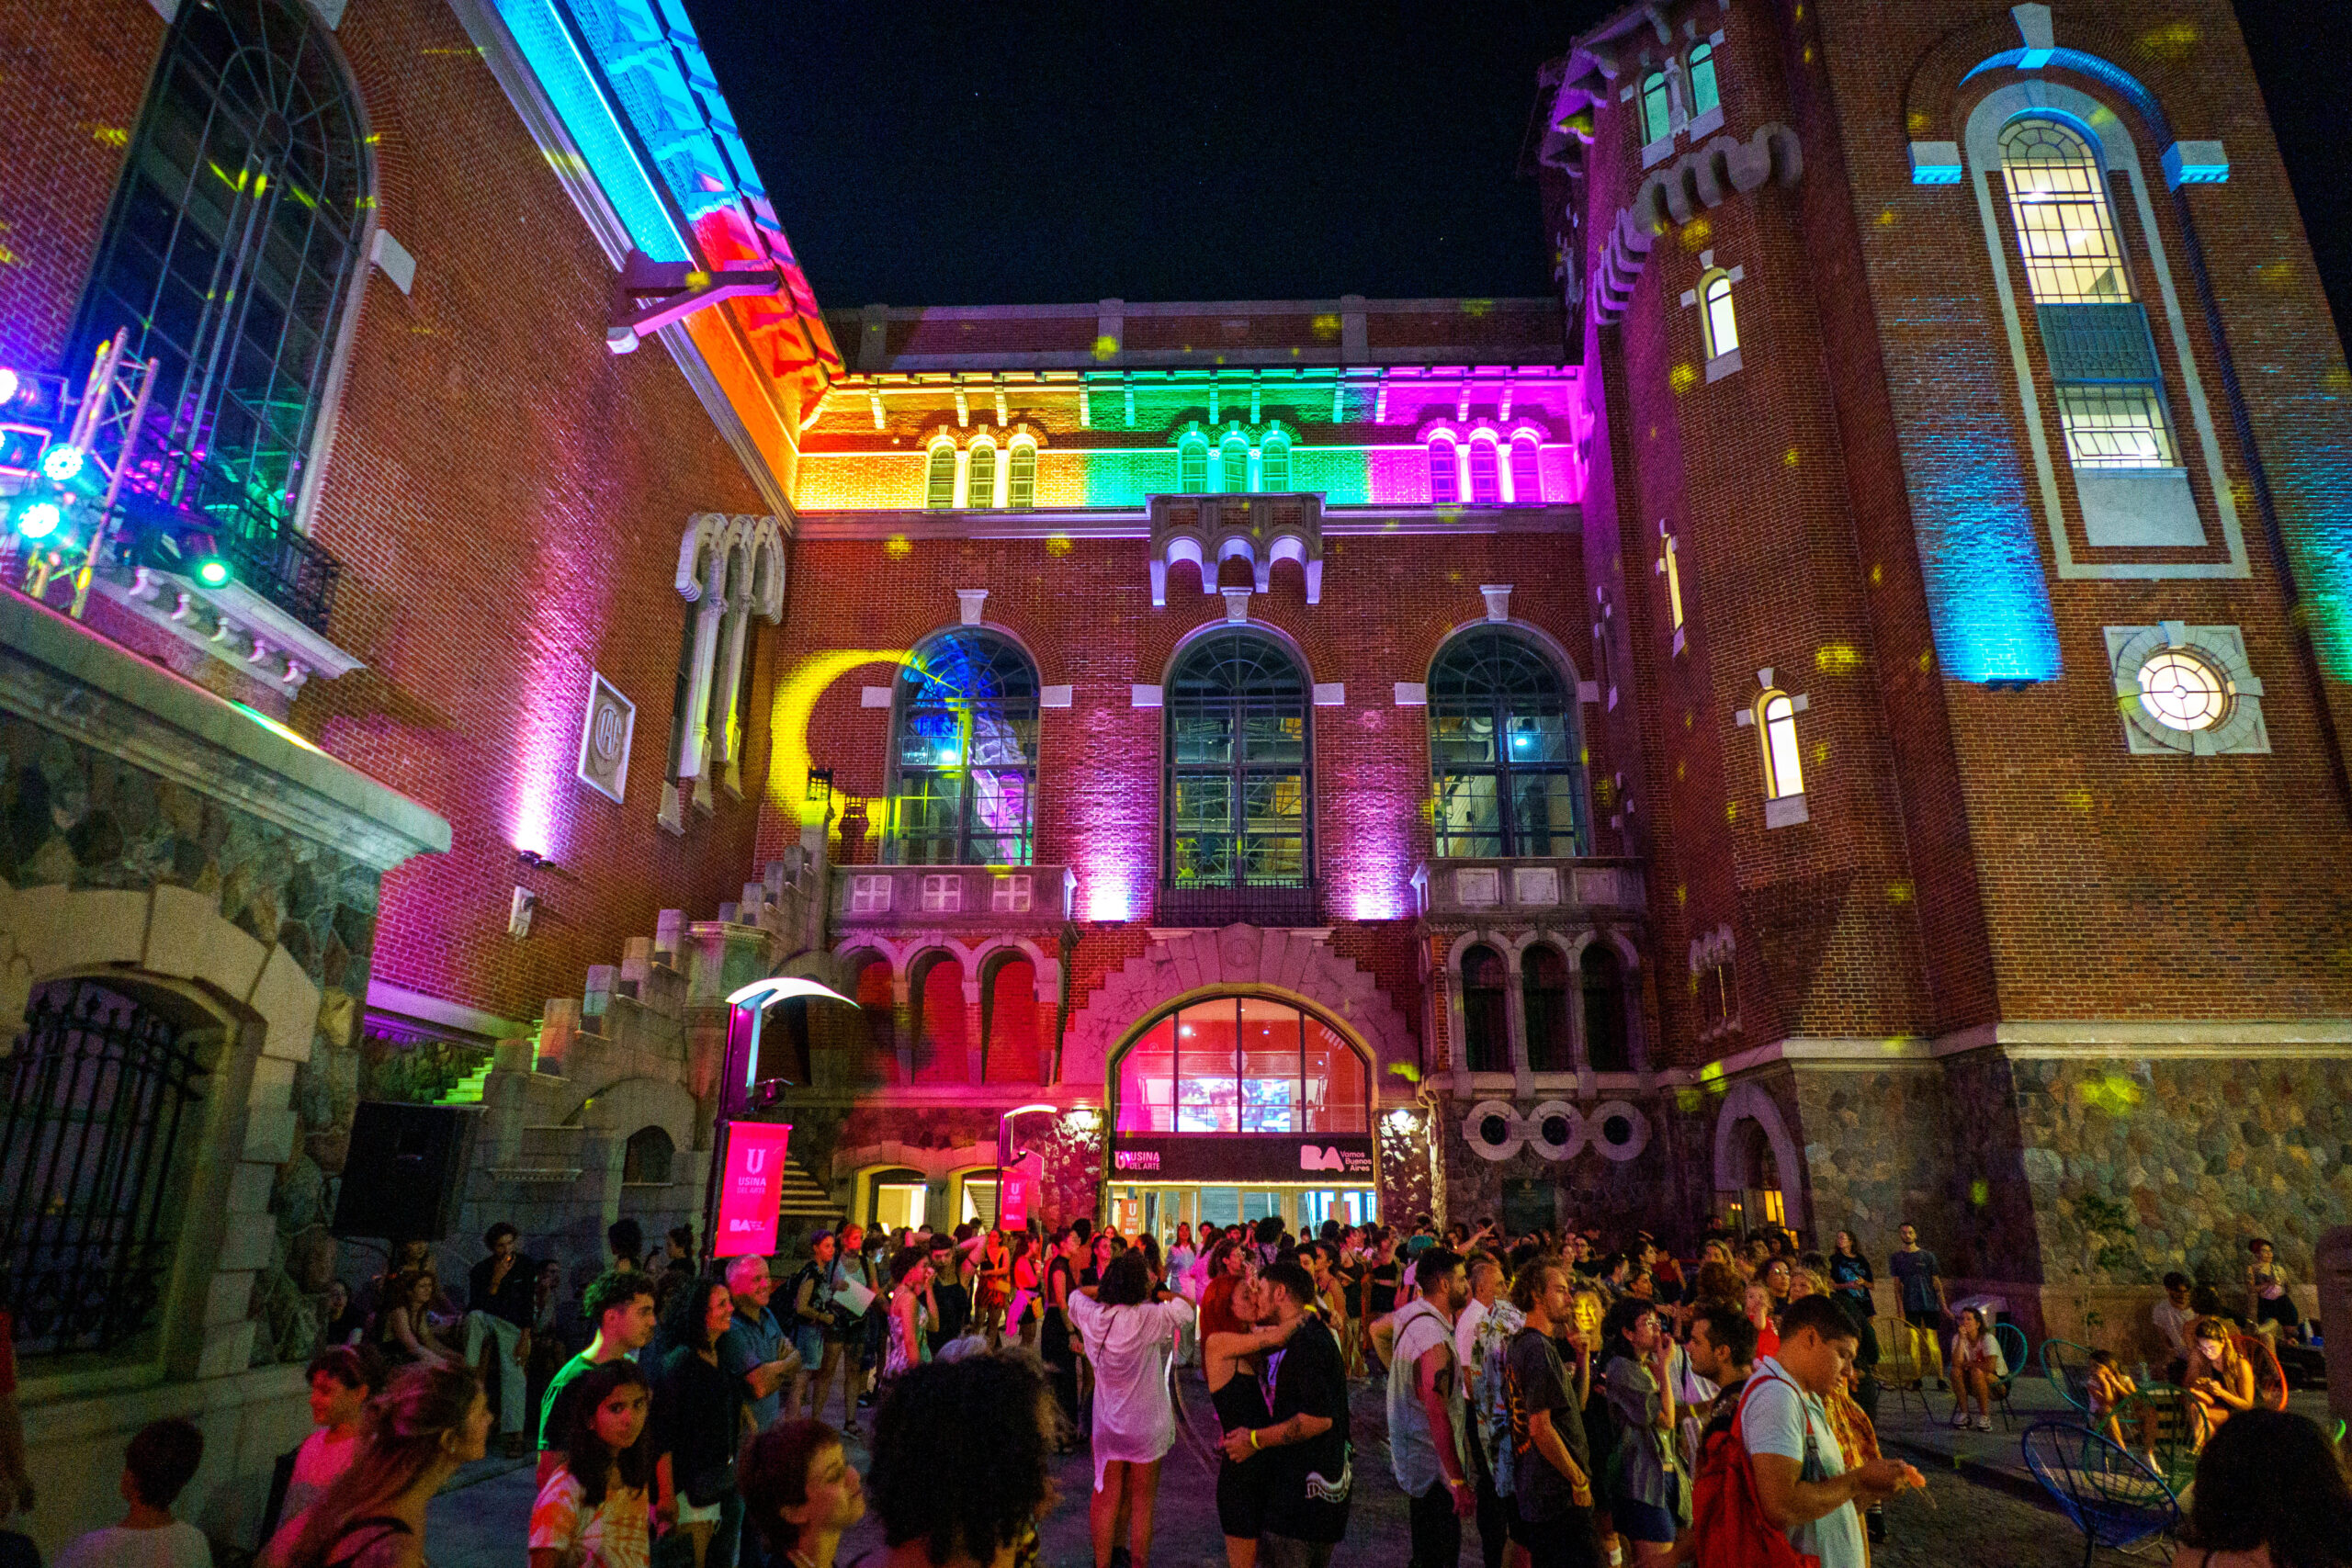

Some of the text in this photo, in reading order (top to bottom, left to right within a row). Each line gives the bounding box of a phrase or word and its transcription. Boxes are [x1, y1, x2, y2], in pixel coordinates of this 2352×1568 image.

[1114, 1151, 1127, 1170] U
[1130, 1151, 1160, 1162] USINA
[1301, 1145, 1344, 1172] BA
[1340, 1150, 1365, 1158] Vamos
[747, 1149, 766, 1174] U
[738, 1177, 766, 1186] USINA
[1012, 1182, 1020, 1195] U
[1129, 1203, 1137, 1216] U
[729, 1219, 751, 1232] BA
